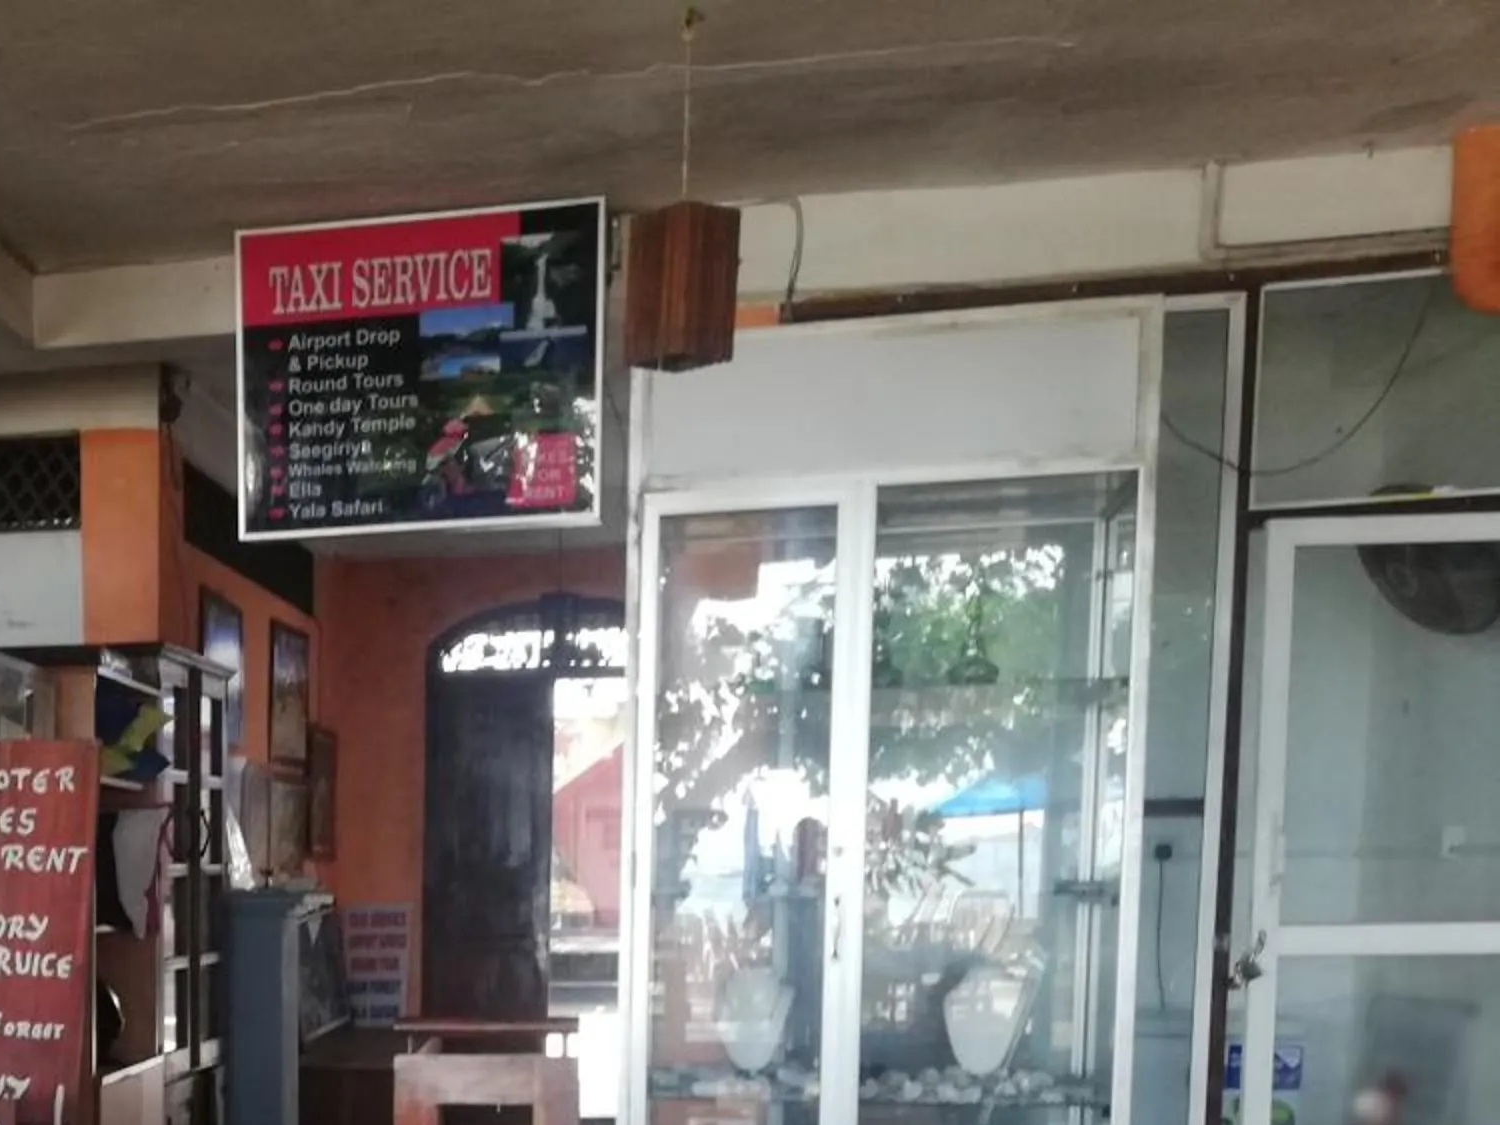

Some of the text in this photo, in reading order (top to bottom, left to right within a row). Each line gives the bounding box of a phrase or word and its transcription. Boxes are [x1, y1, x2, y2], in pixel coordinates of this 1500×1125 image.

[269, 249, 492, 315] TAXI SERVICE
[288, 328, 401, 352] Airport Drop
[289, 353, 369, 372] & Pickup
[289, 373, 404, 394] Round Tours
[288, 393, 418, 416] One day Tours
[288, 413, 416, 439] Kandy Temple
[289, 481, 322, 499] Ella
[289, 499, 383, 519] Yala Safari
[0, 845, 88, 874] RENT
